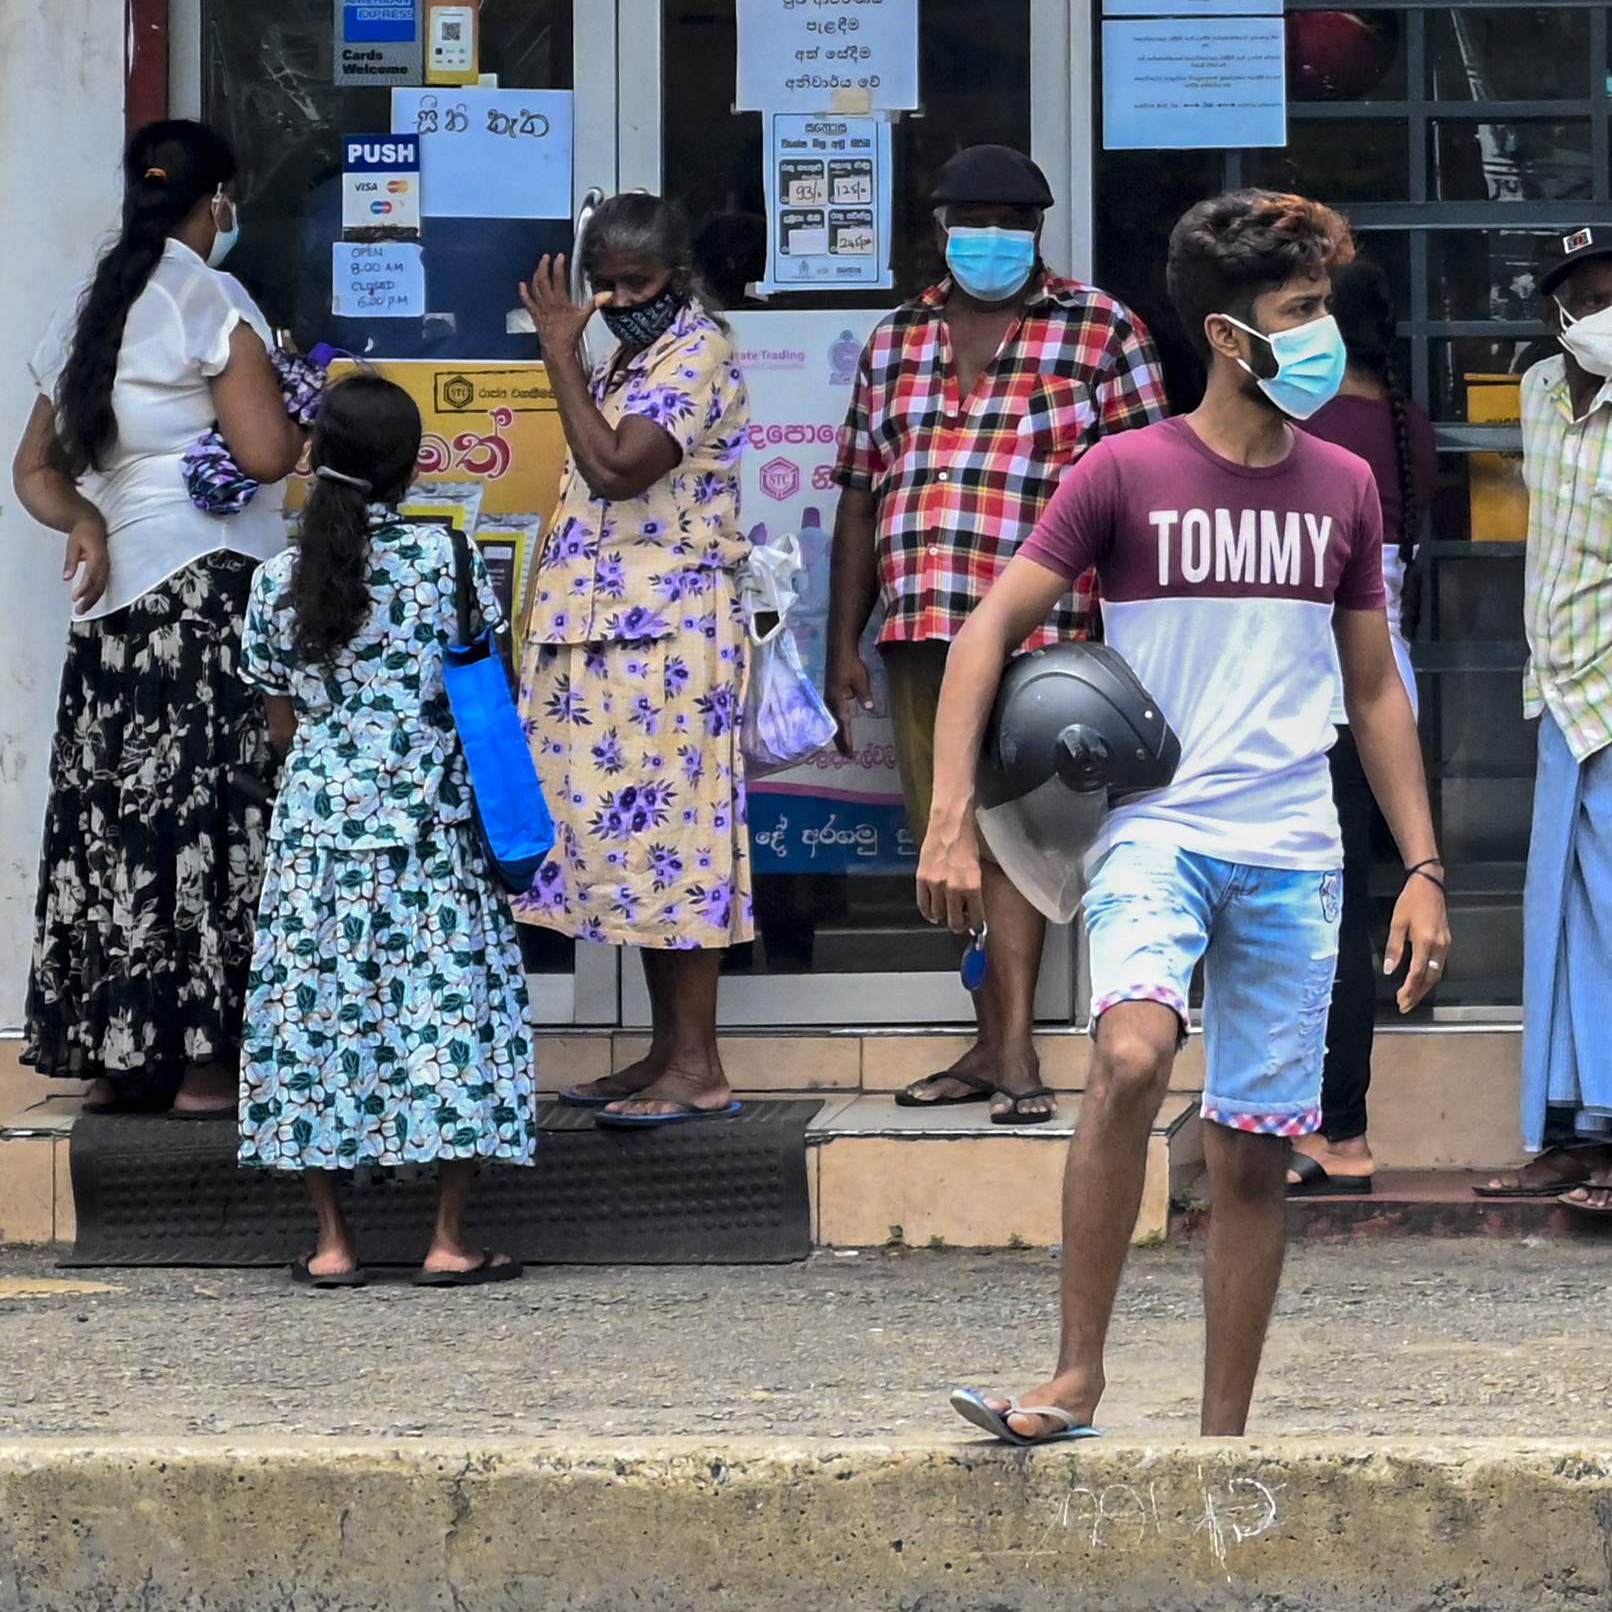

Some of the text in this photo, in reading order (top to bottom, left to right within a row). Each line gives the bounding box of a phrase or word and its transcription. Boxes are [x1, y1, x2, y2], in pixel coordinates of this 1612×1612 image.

[359, 8, 415, 20] EXPRESS
[342, 48, 383, 61] Cards
[342, 63, 409, 75] Welcome
[348, 143, 415, 164] PUSH
[355, 182, 378, 192] VISA
[351, 247, 383, 258] OPEN
[350, 261, 381, 277] 8.00
[351, 280, 396, 292] CLOSED
[761, 350, 806, 362] Trading
[769, 474, 791, 485] STC
[1148, 507, 1333, 588] TOMMY
